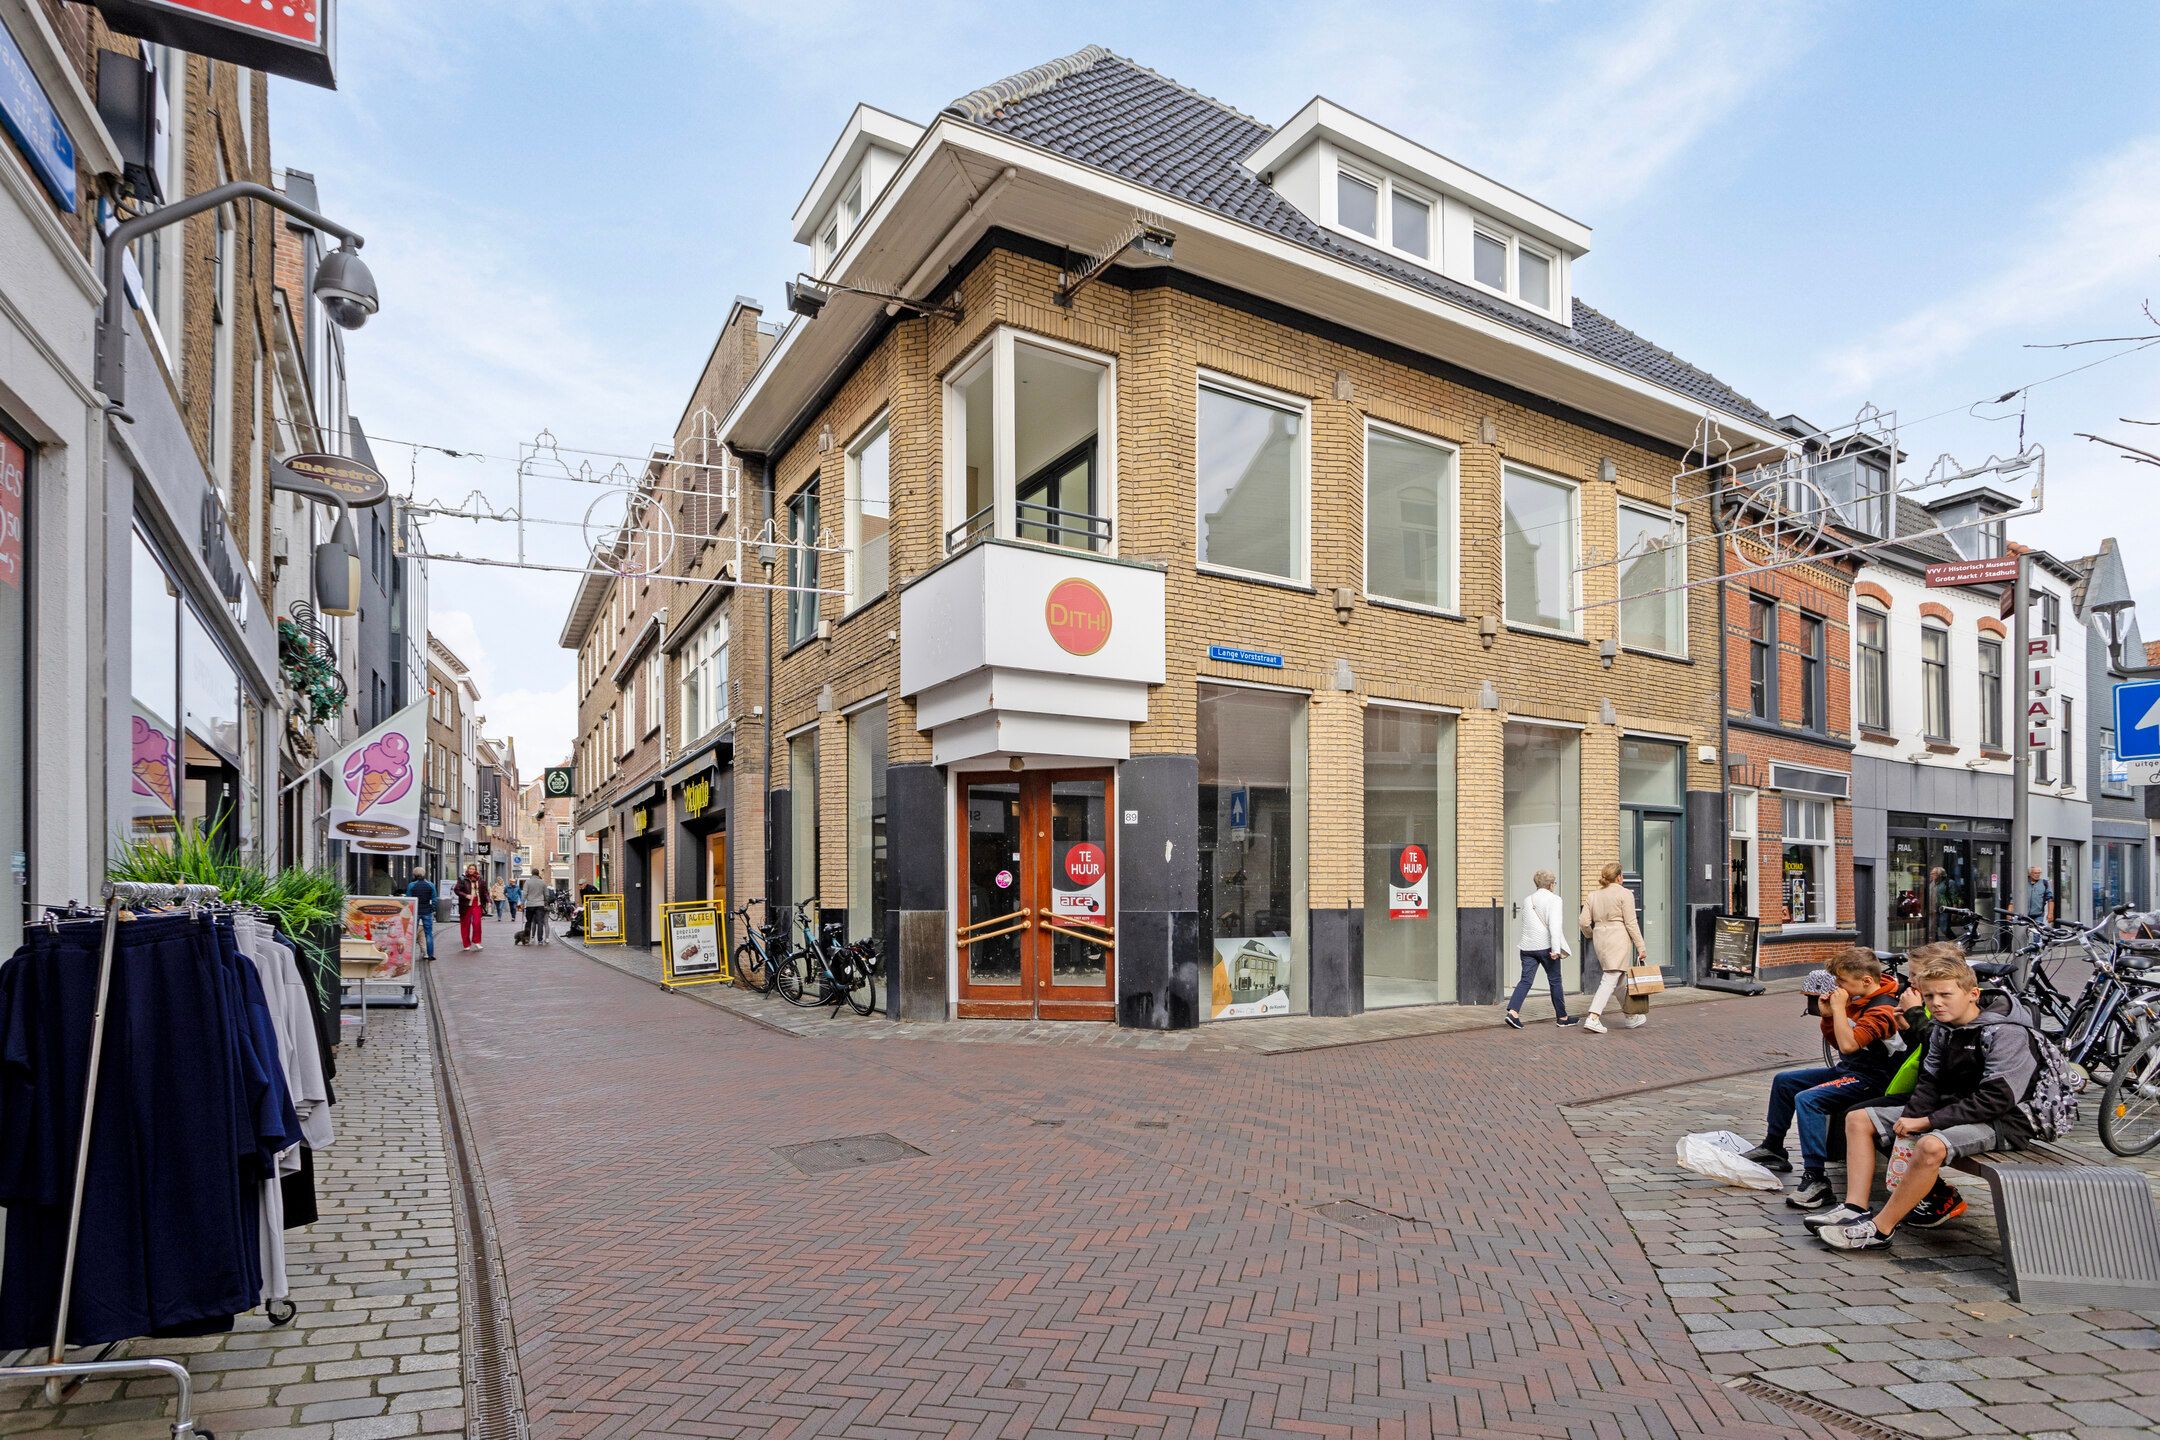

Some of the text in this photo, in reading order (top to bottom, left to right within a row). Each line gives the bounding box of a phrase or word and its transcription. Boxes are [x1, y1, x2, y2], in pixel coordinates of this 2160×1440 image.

[292, 460, 379, 483] maestro
[1927, 567, 1941, 575] VVV
[1948, 563, 1984, 573] Historisch
[1986, 560, 2016, 569] Museum
[1957, 573, 1978, 581] Markt
[1985, 569, 2016, 578] Stadhuis
[1217, 648, 1277, 664] Lange Vorststraat
[2028, 639, 2050, 748] RIAL
[1125, 813, 1137, 822] 89
[1898, 843, 1913, 852] RIAL
[1943, 845, 1957, 854] RIAL
[1980, 847, 1994, 855] RIAL
[1079, 850, 1092, 863] TE
[1409, 851, 1418, 863] TE
[1071, 863, 1100, 875] HUUR
[1403, 863, 1423, 874] HUUR
[1060, 896, 1094, 907] arca
[1397, 892, 1418, 902] arca
[688, 912, 714, 922] ACTIE!
